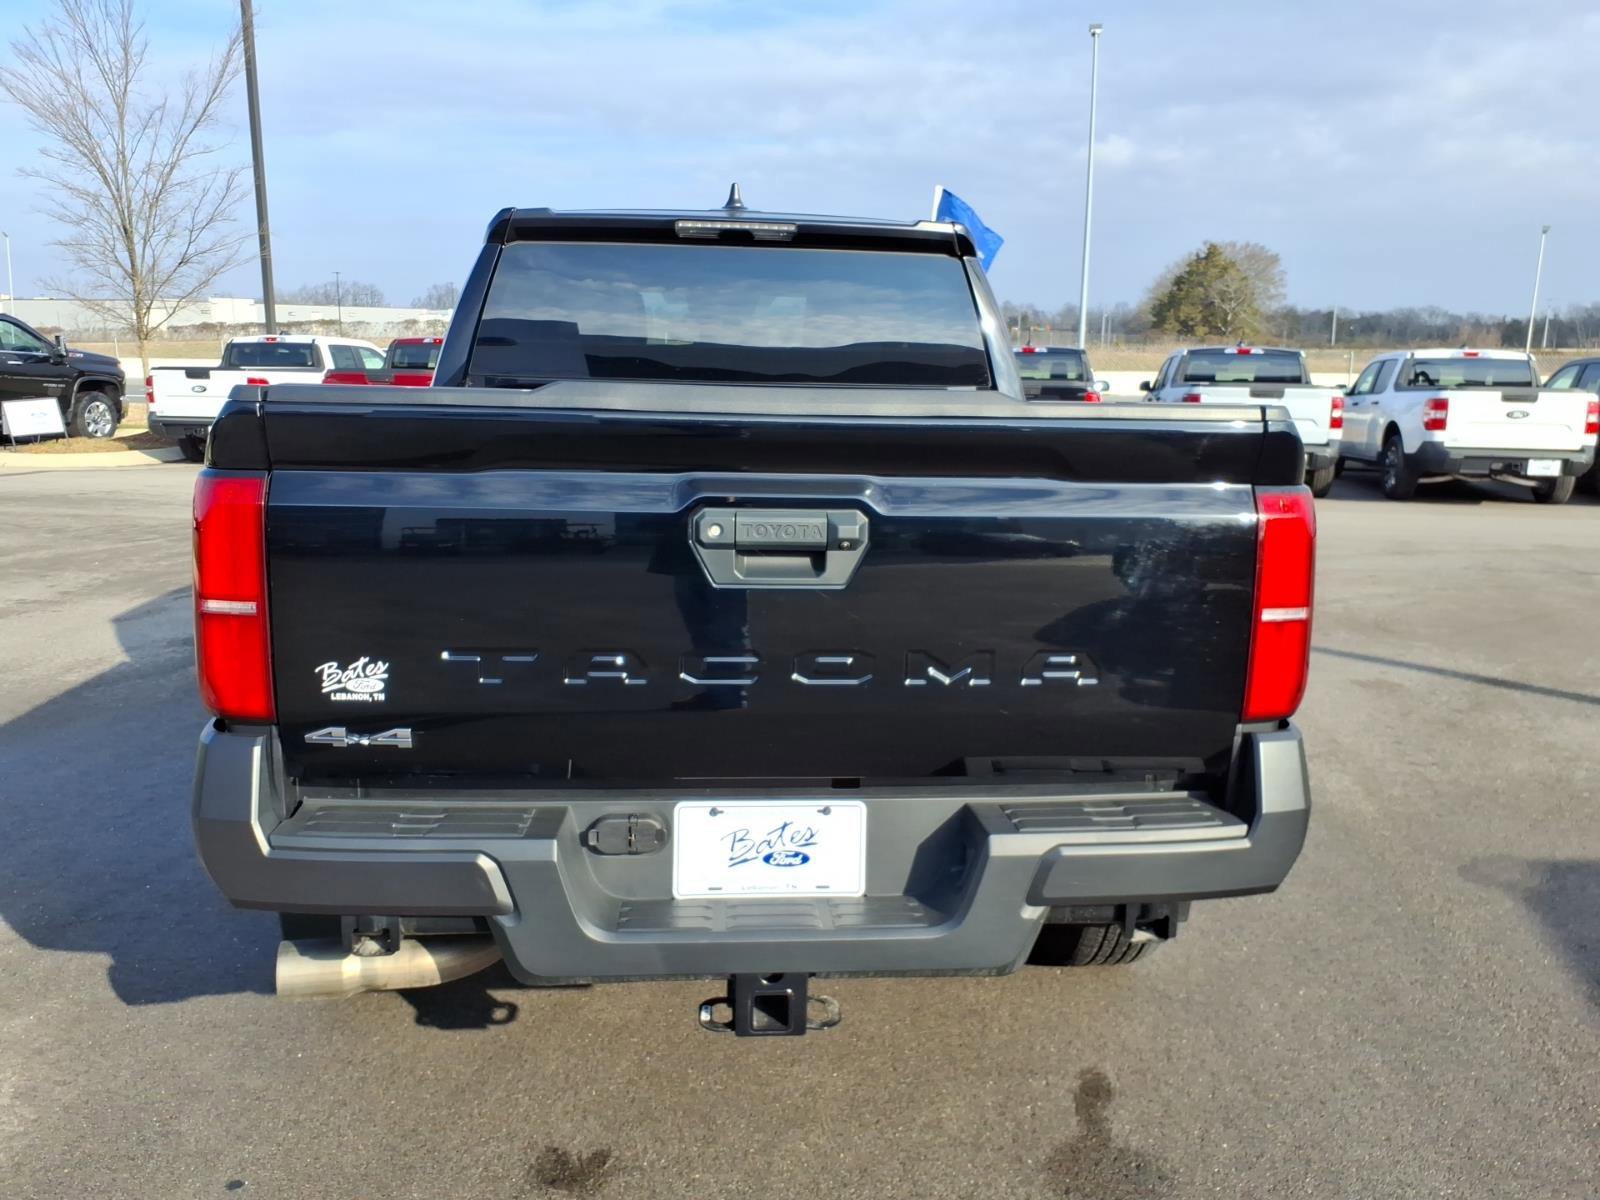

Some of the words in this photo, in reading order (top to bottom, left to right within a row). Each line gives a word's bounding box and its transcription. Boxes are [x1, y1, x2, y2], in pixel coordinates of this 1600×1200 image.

[741, 523, 823, 539] TOYOTA
[314, 656, 389, 689] Bates
[441, 649, 1099, 685] TACOMA
[720, 821, 820, 864] Bates
[769, 851, 805, 866] Ford
